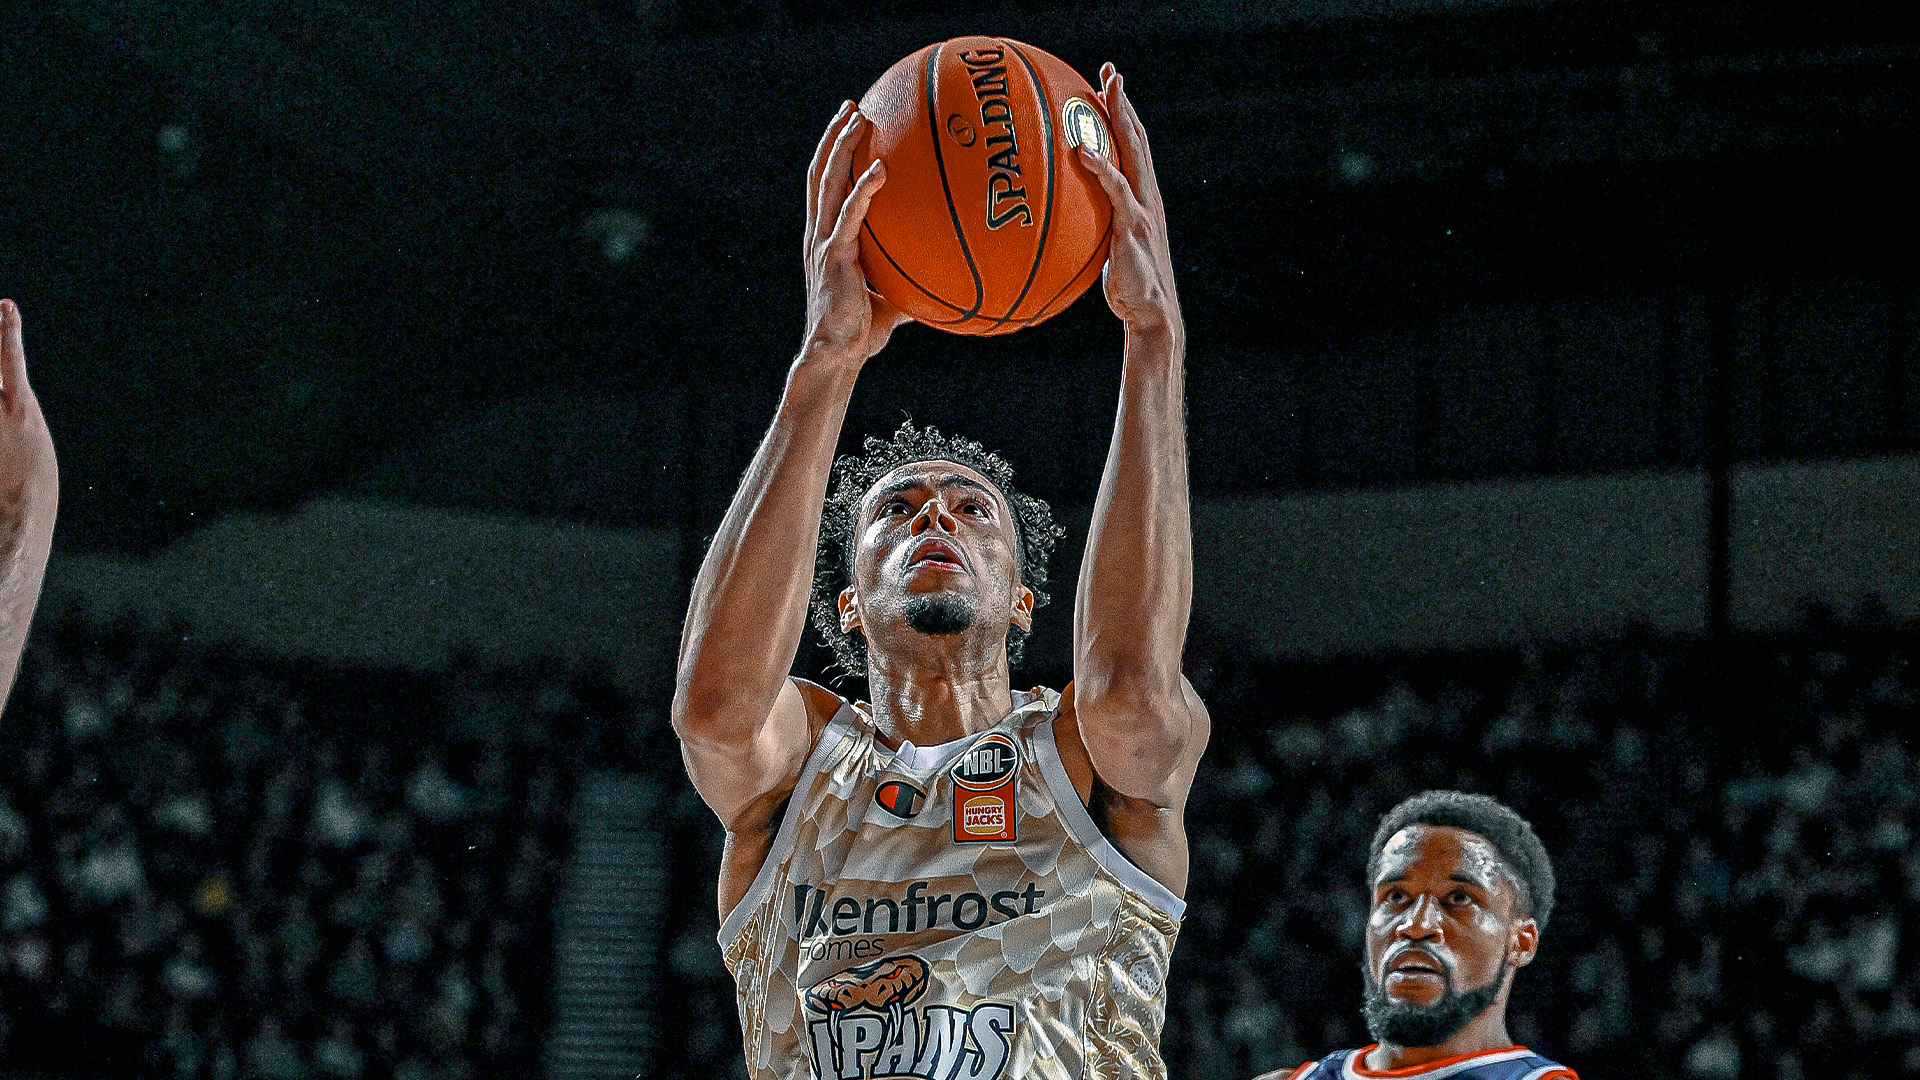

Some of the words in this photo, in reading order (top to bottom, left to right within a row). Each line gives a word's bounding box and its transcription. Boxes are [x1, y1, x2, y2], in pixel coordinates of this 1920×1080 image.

[958, 46, 1034, 231] SPALDING
[963, 748, 1004, 776] NBL
[965, 806, 1003, 816] HUNGRY
